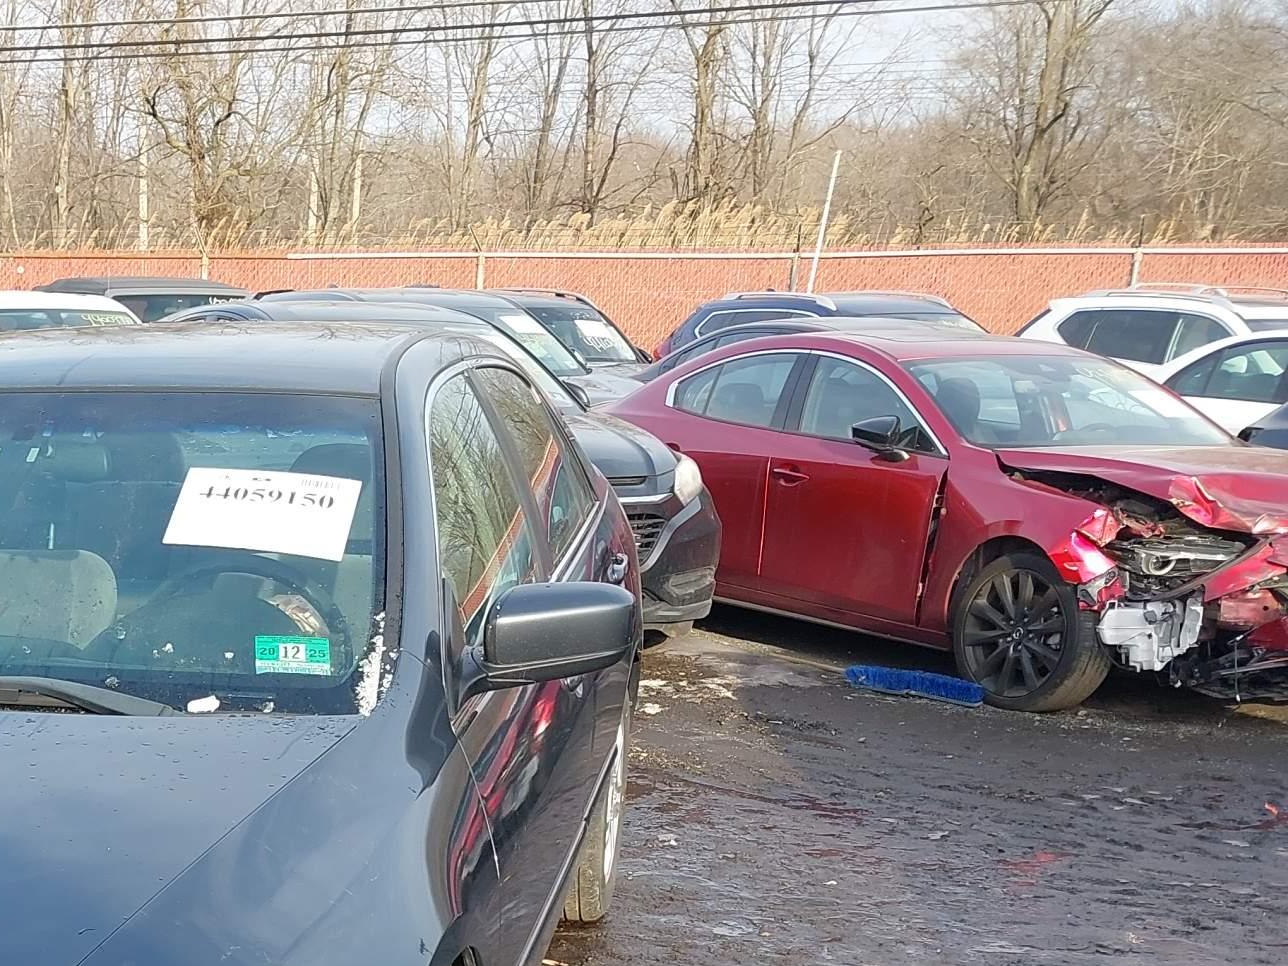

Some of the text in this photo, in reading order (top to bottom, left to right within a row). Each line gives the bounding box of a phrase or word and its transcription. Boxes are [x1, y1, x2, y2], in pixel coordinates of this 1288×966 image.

[199, 485, 334, 510] 44059150
[259, 645, 326, 659] 20 12 25
